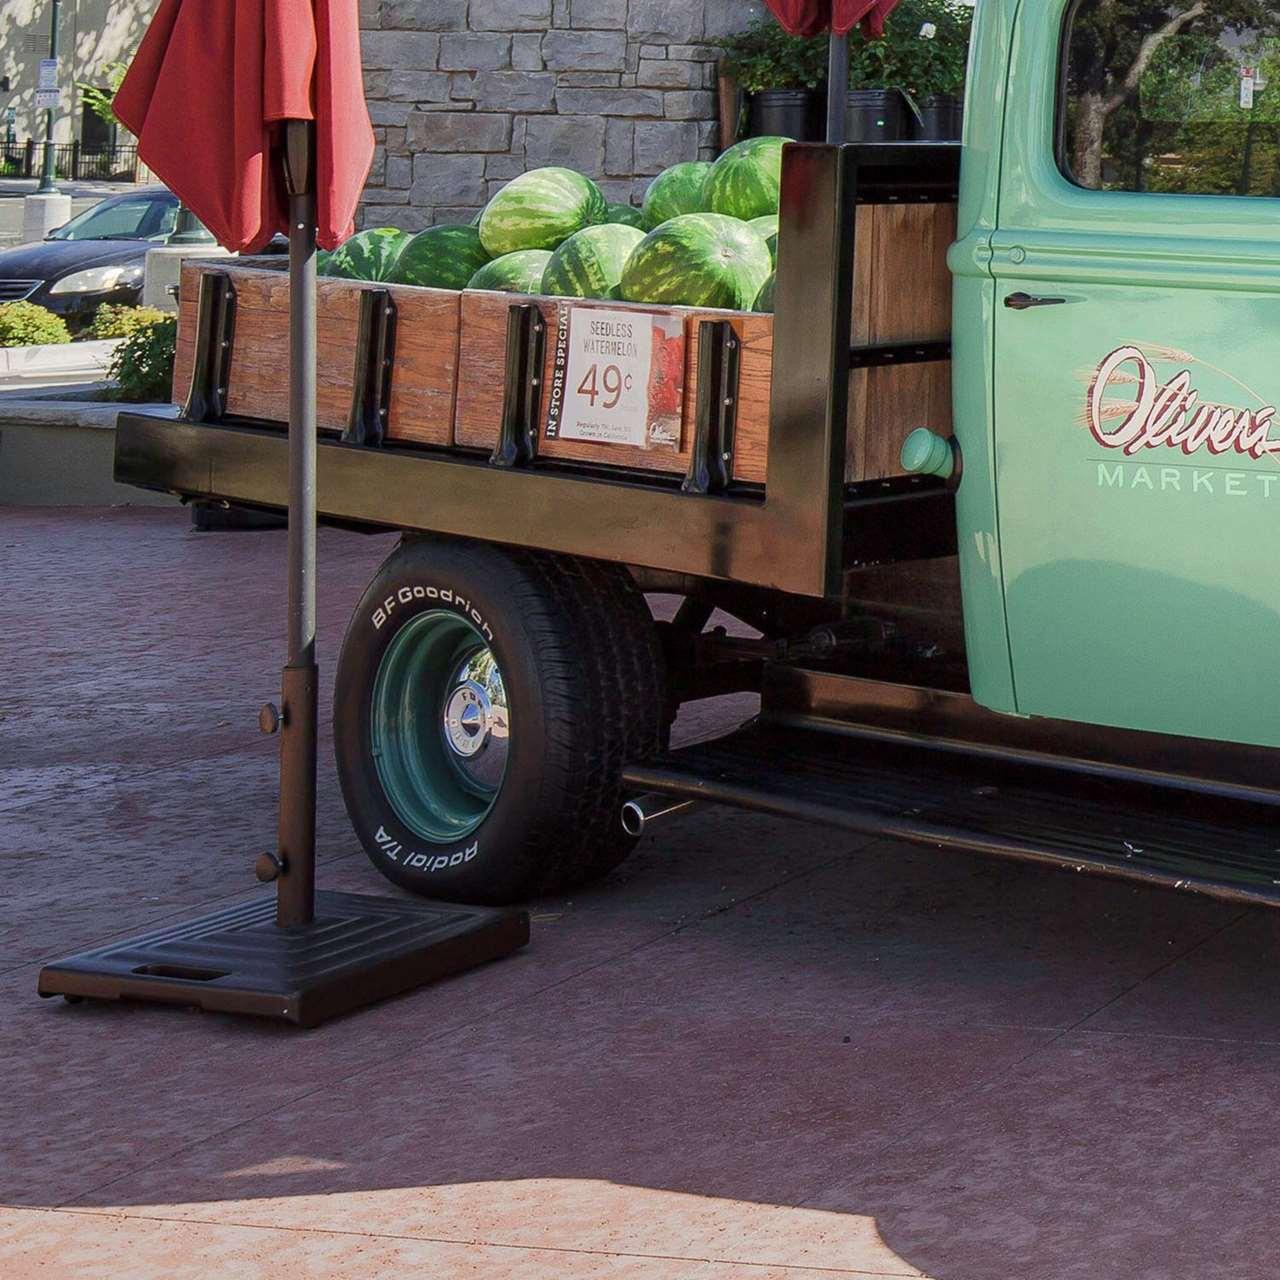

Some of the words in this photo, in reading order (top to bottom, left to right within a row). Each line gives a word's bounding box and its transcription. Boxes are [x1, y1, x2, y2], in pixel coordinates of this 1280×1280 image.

[557, 303, 569, 365] SPECIAL
[591, 320, 633, 338] SEEDLESS
[584, 338, 638, 357] WATERMELON
[550, 369, 564, 415] STORE
[546, 420, 557, 436] IN
[374, 825, 406, 860] T/A
[403, 840, 479, 872] Radial
